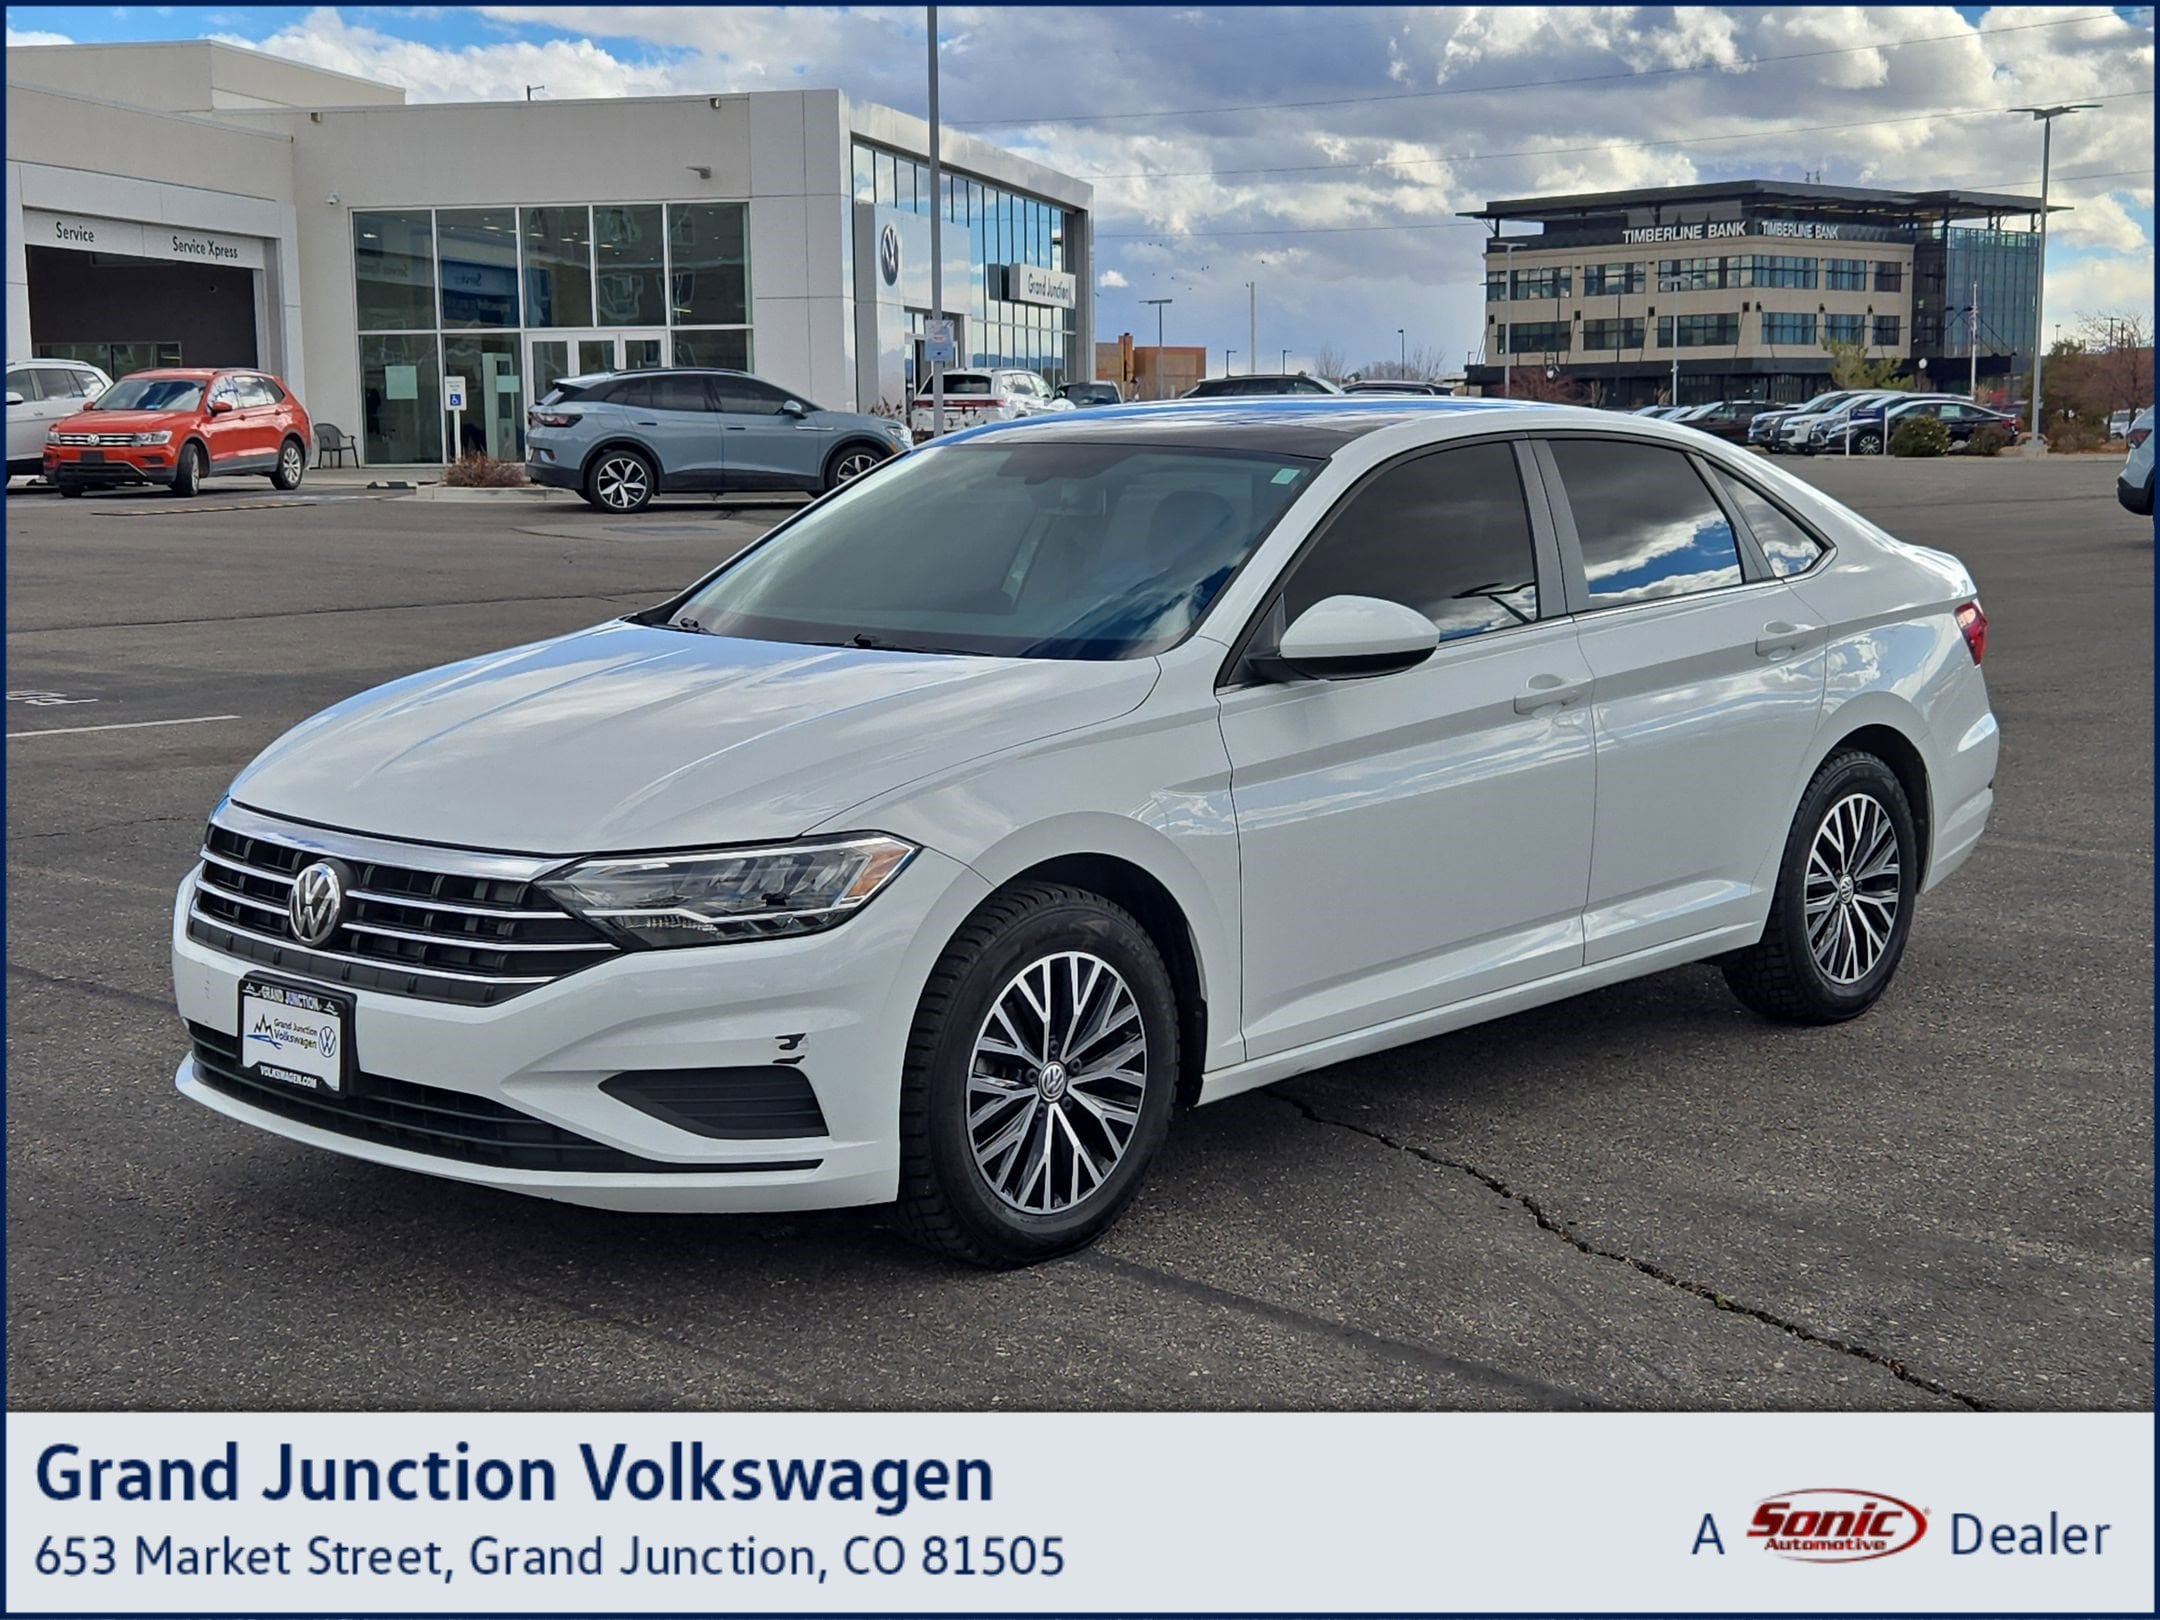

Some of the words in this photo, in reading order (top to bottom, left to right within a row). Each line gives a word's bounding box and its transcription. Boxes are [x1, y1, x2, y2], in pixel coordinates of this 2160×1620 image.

[56, 221, 95, 243] Service
[1622, 223, 1703, 244] TIMBERLINE
[1708, 221, 1746, 239] BANK
[1761, 220, 1814, 239] TIMBERLINE
[1815, 223, 1839, 240] BANK
[172, 235, 206, 255] Service
[207, 240, 238, 260] Xpress
[1028, 272, 1047, 296] Grand
[274, 1018, 292, 1030] Grand
[293, 1022, 318, 1037] Junction
[274, 1028, 318, 1050] Volkswagen
